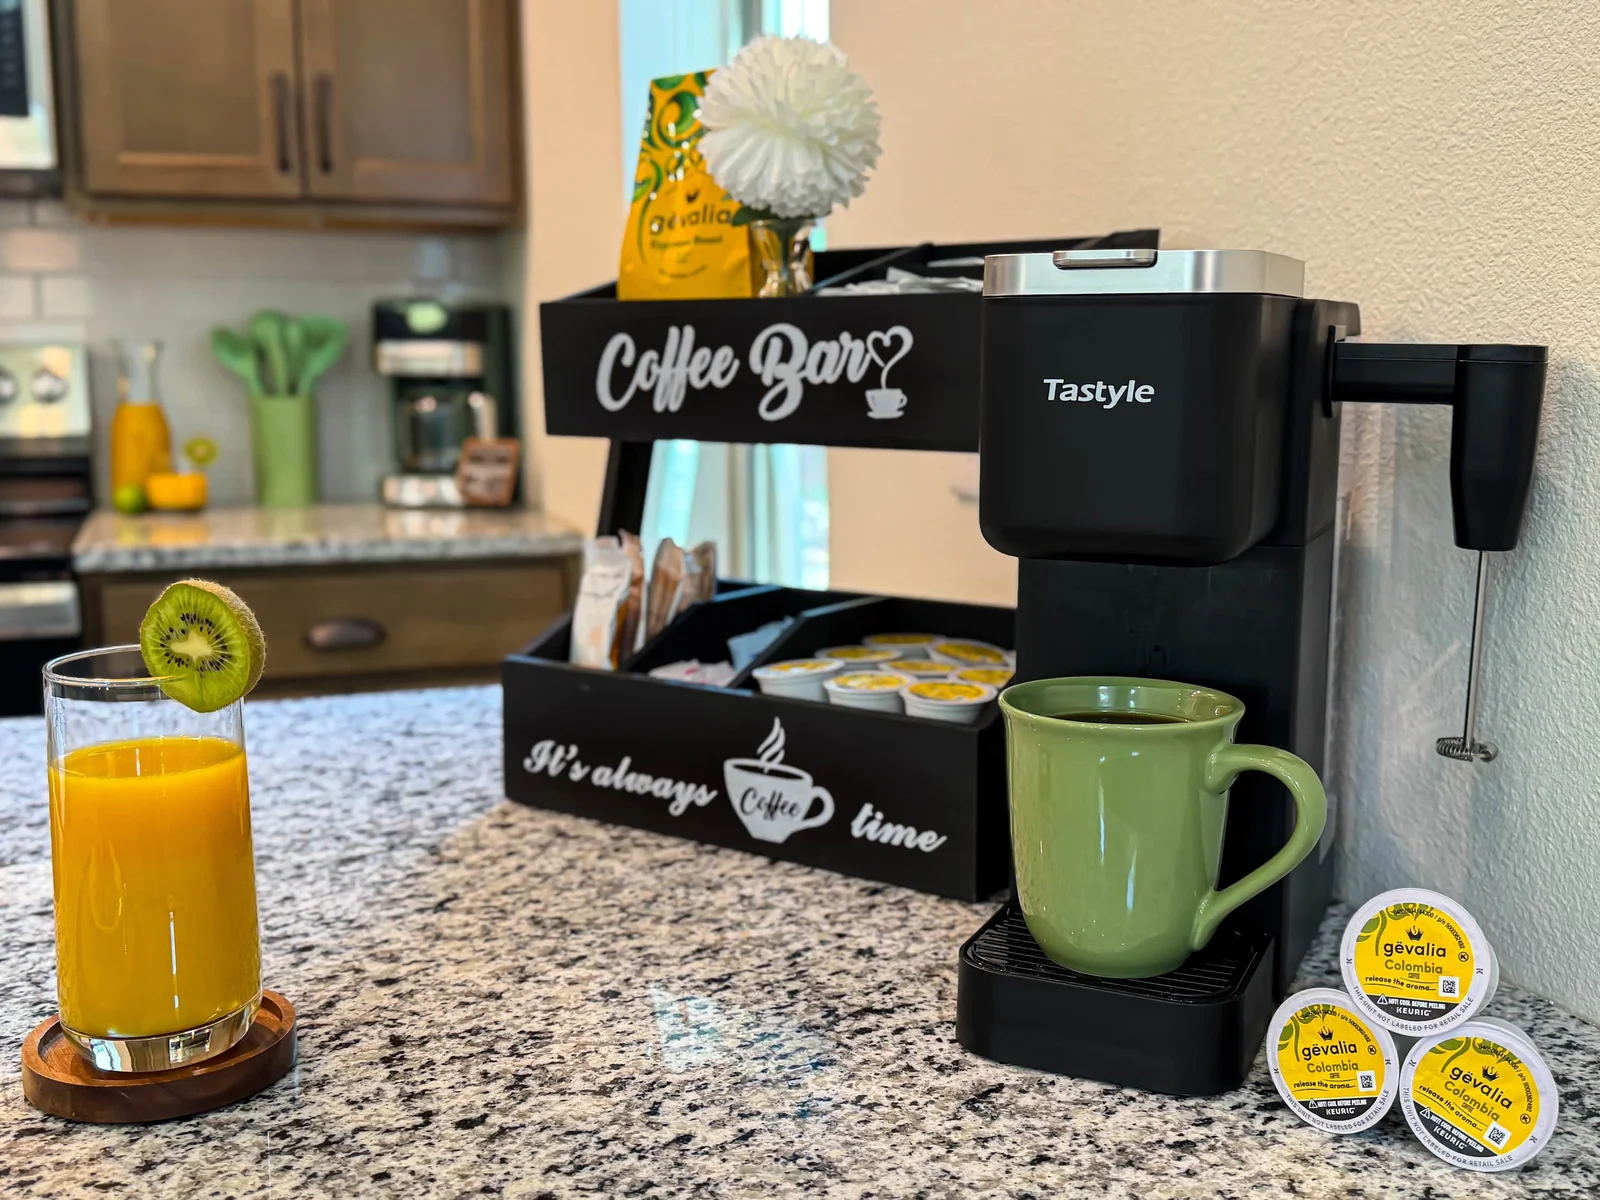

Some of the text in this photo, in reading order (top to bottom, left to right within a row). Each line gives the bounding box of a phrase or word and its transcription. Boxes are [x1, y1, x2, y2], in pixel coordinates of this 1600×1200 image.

[595, 323, 872, 421] Coffee Bar
[1043, 378, 1155, 409] Tastyle
[523, 740, 947, 852] It's always Coffee time
[1384, 942, 1446, 957] gëvalia
[1385, 960, 1443, 975] Colombia
[1394, 978, 1404, 986] the
[1353, 985, 1363, 1000] THIS
[1363, 1001, 1376, 1014] UNIT
[1377, 1013, 1390, 1023] NOT
[1392, 1021, 1422, 1032] LABELED
[1439, 1013, 1460, 1027] RETAIL
[1459, 997, 1473, 1013] SALE
[1302, 1042, 1358, 1061] gëvalia
[1307, 1061, 1359, 1073] Colombia
[1318, 1080, 1328, 1088] the
[1449, 1067, 1513, 1109] gëvalia
[1419, 1086, 1444, 1102] release
[1444, 1099, 1455, 1112] the
[1444, 1080, 1500, 1121] Colombia
[1405, 1105, 1415, 1121] UNIT
[1412, 1121, 1424, 1136] NOT
[1423, 1136, 1451, 1158] LABELED
[1452, 1155, 1467, 1164] FOR
[1495, 1155, 1513, 1166] SALE
